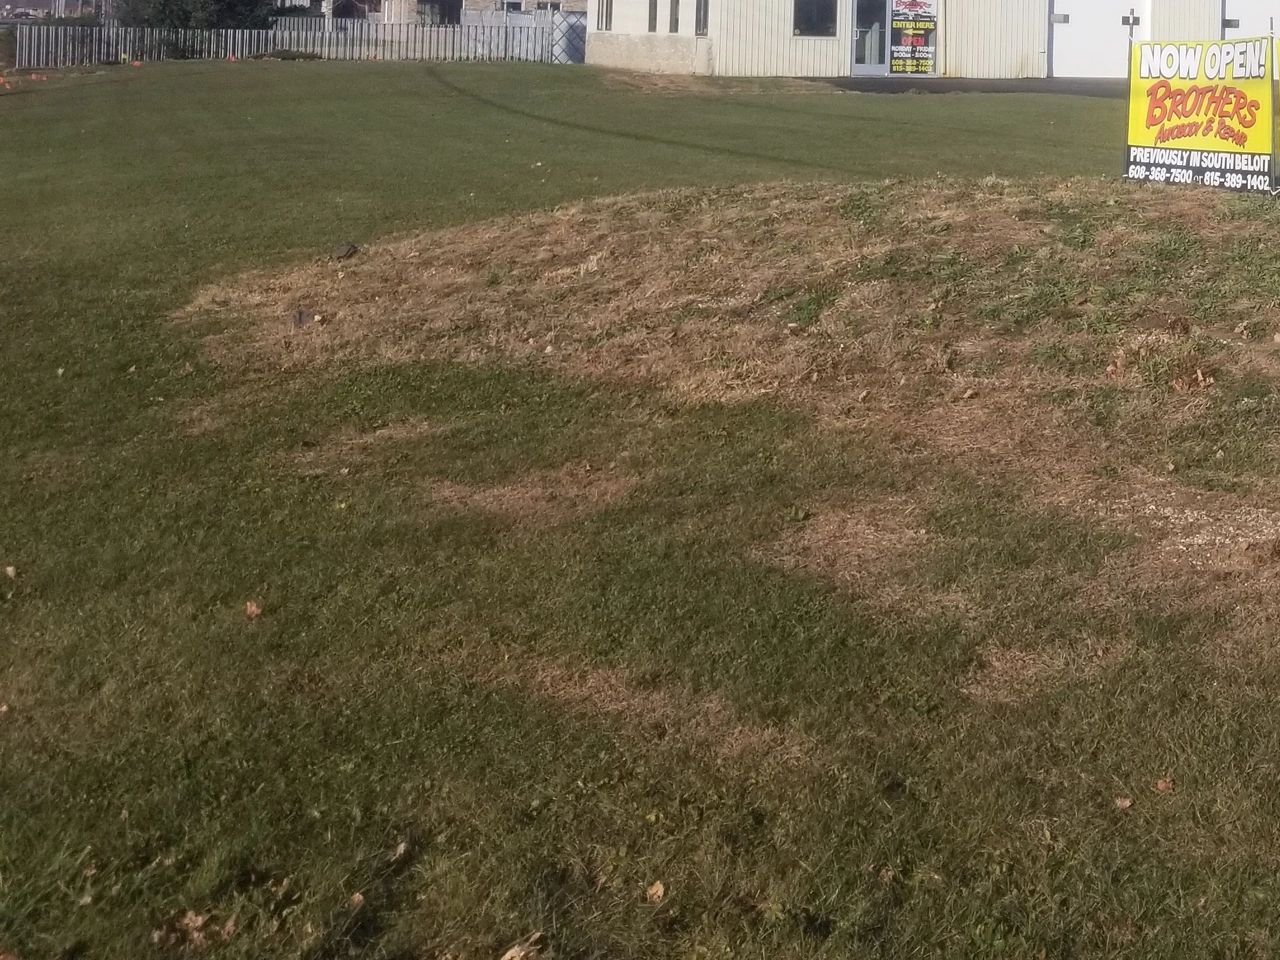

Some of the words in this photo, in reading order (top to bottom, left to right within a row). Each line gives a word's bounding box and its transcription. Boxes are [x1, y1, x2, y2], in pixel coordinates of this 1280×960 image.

[892, 21, 915, 29] ENTER
[916, 21, 935, 29] HERE
[901, 36, 925, 46] OPEN
[1140, 43, 1203, 80] NOW
[1204, 38, 1269, 80] OPEN!
[1146, 80, 1260, 129] BROTHERS
[1154, 121, 1204, 146] AUTOBODY
[1202, 117, 1215, 137] &
[1214, 118, 1248, 148] REPAIR
[1130, 147, 1190, 166] PREVIOUSLY
[1189, 152, 1200, 167] IN
[1201, 153, 1236, 170] SOUTH
[1235, 154, 1271, 172] BELOIT
[1128, 164, 1193, 184] 608-368-7500
[1203, 171, 1270, 191] 815-389-1402
